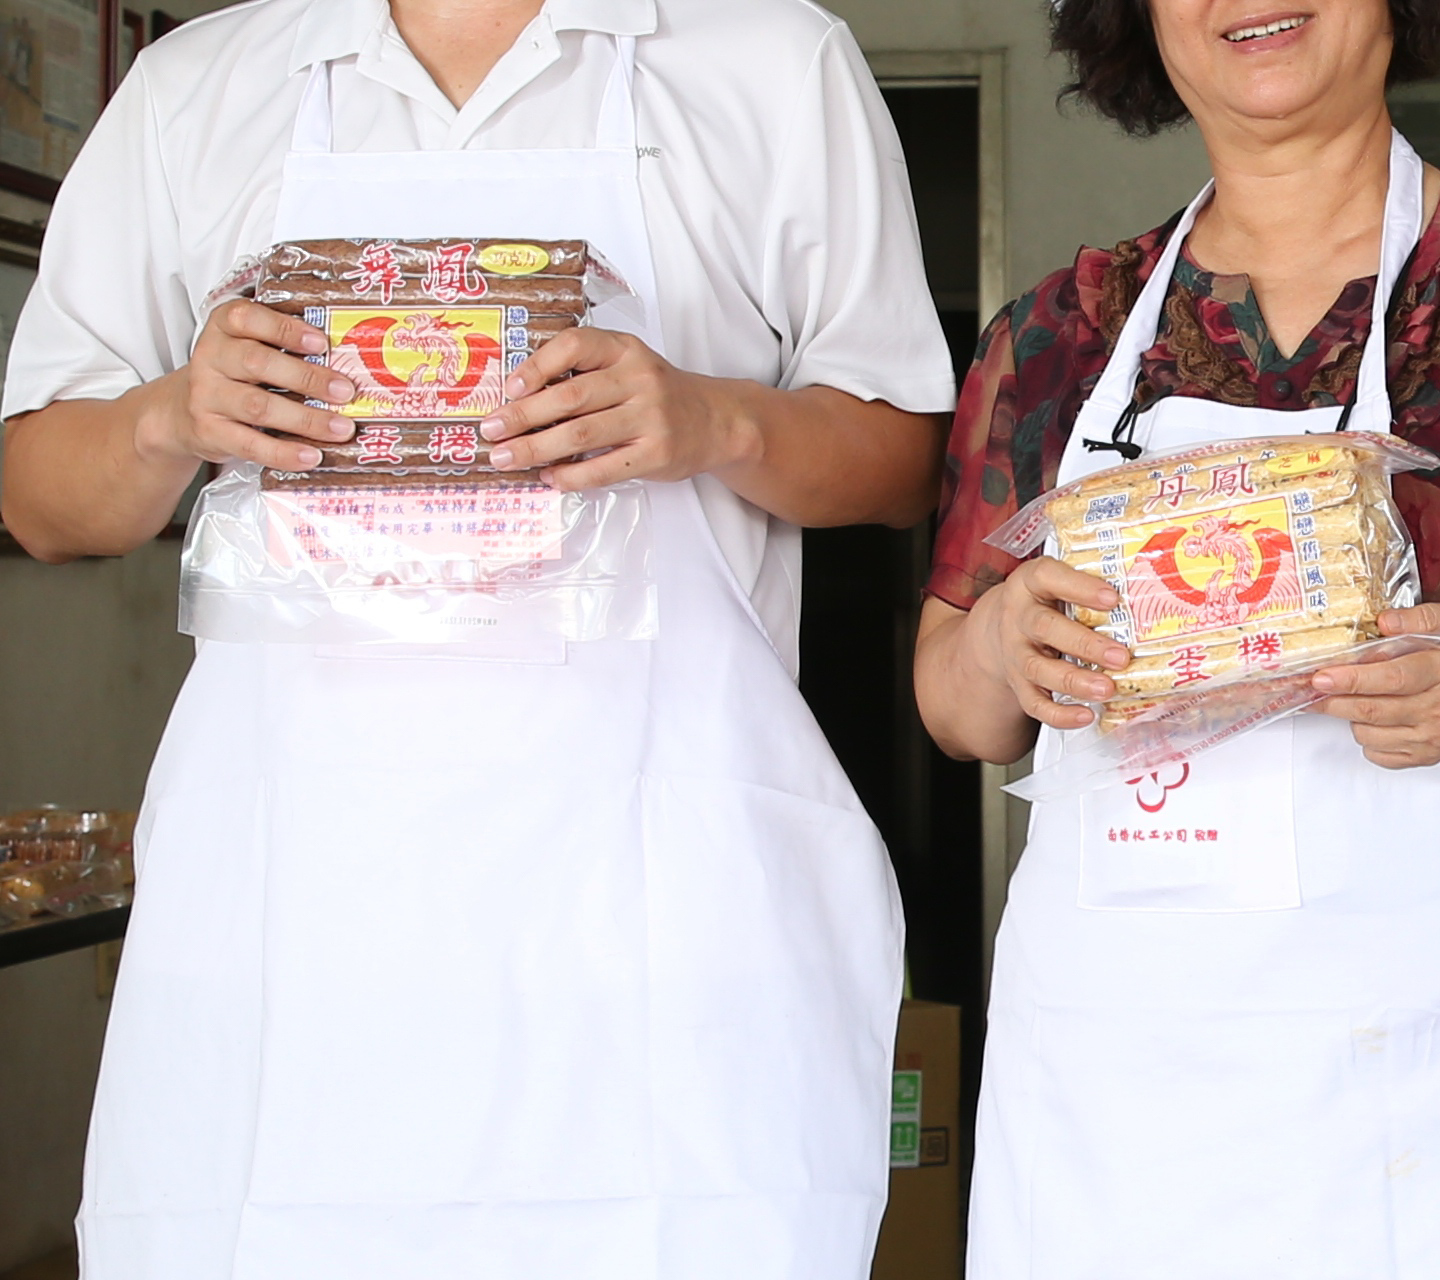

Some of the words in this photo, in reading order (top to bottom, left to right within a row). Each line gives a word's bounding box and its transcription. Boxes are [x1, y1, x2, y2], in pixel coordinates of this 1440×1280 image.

[344, 243, 487, 304] 舞鳳
[493, 251, 538, 266] 巧克力
[357, 425, 478, 464] 蛋捲
[1145, 463, 1255, 510] 丹鳳
[1292, 492, 1327, 610] 戀戀舊風味
[1172, 631, 1285, 689] 蛋捲
